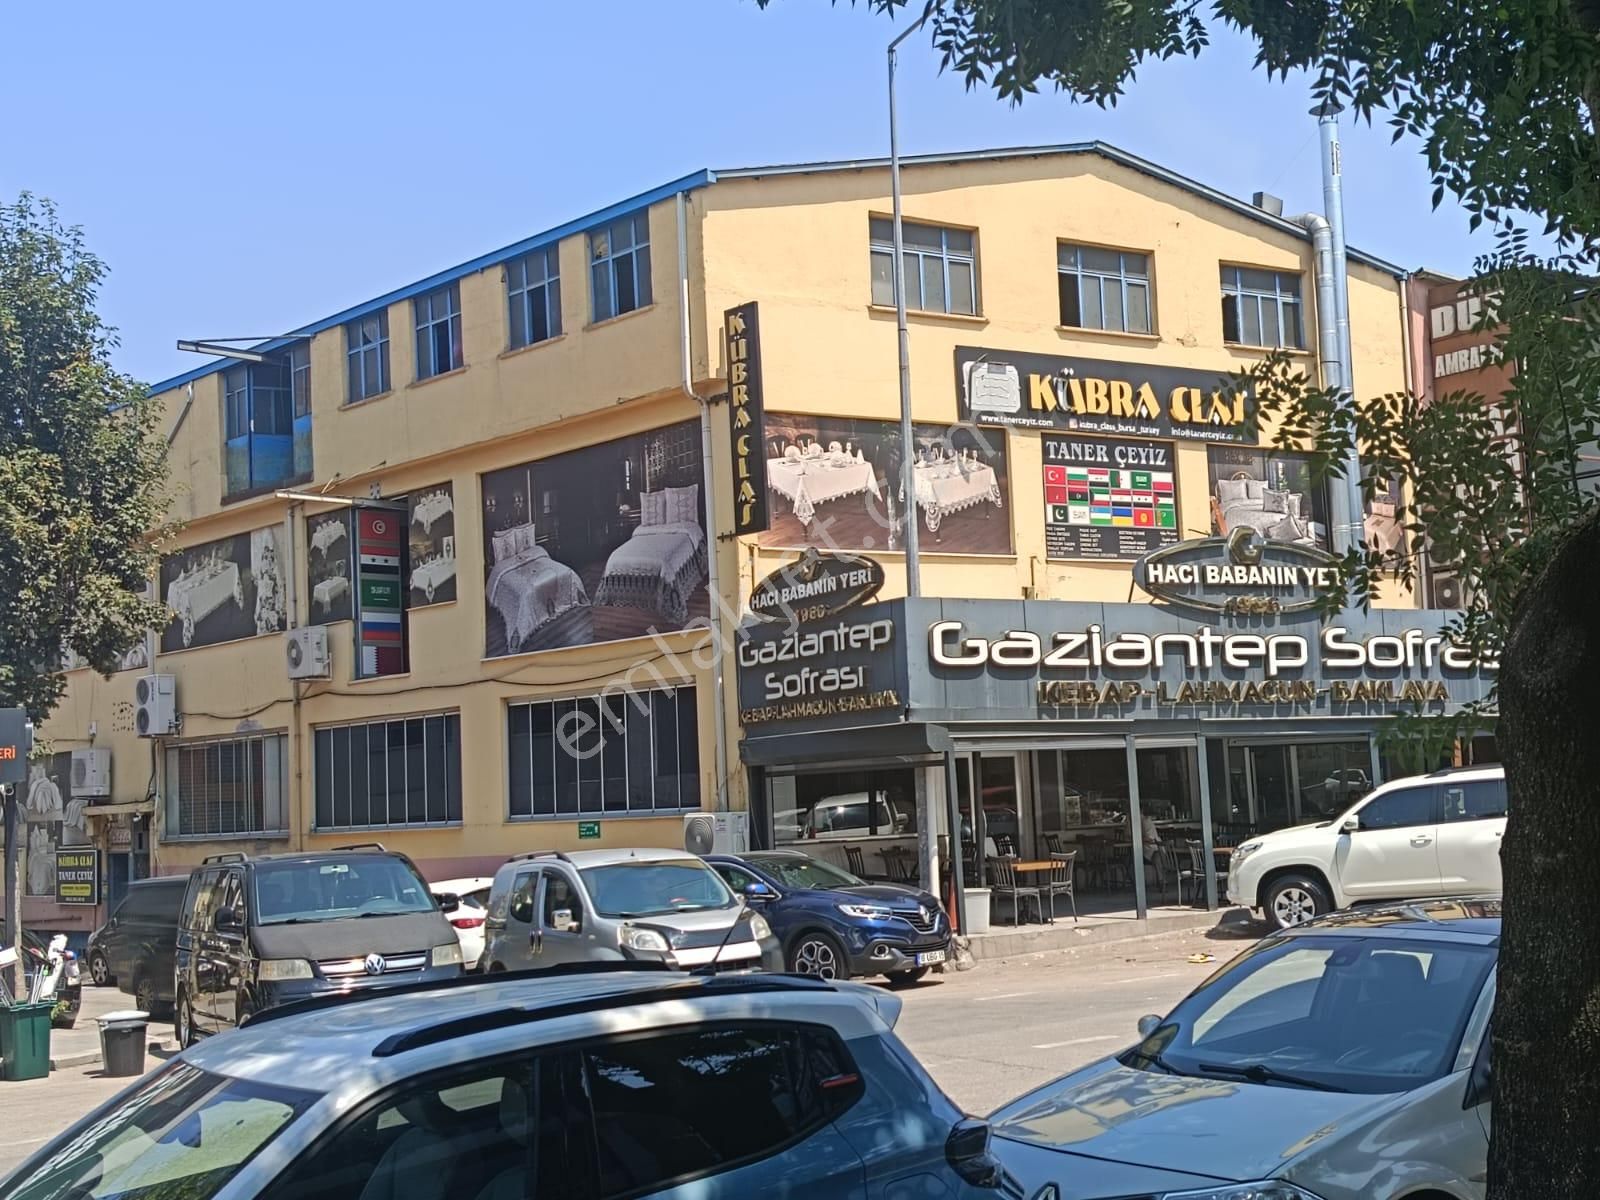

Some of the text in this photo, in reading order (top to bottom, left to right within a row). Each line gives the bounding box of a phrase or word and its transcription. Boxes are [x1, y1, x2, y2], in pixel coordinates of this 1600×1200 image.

[728, 312, 751, 430] KÜBRA
[1029, 368, 1161, 419] KÜBRA
[1046, 441, 1167, 468] TANER ÇEYİZ
[751, 567, 872, 610] HACI BABANIN YERİ
[1147, 563, 1347, 587] HACI BABANIN YE
[738, 618, 895, 668] Gaziantep
[929, 619, 1309, 677] Gaziantep
[764, 665, 865, 701] Sofrası
